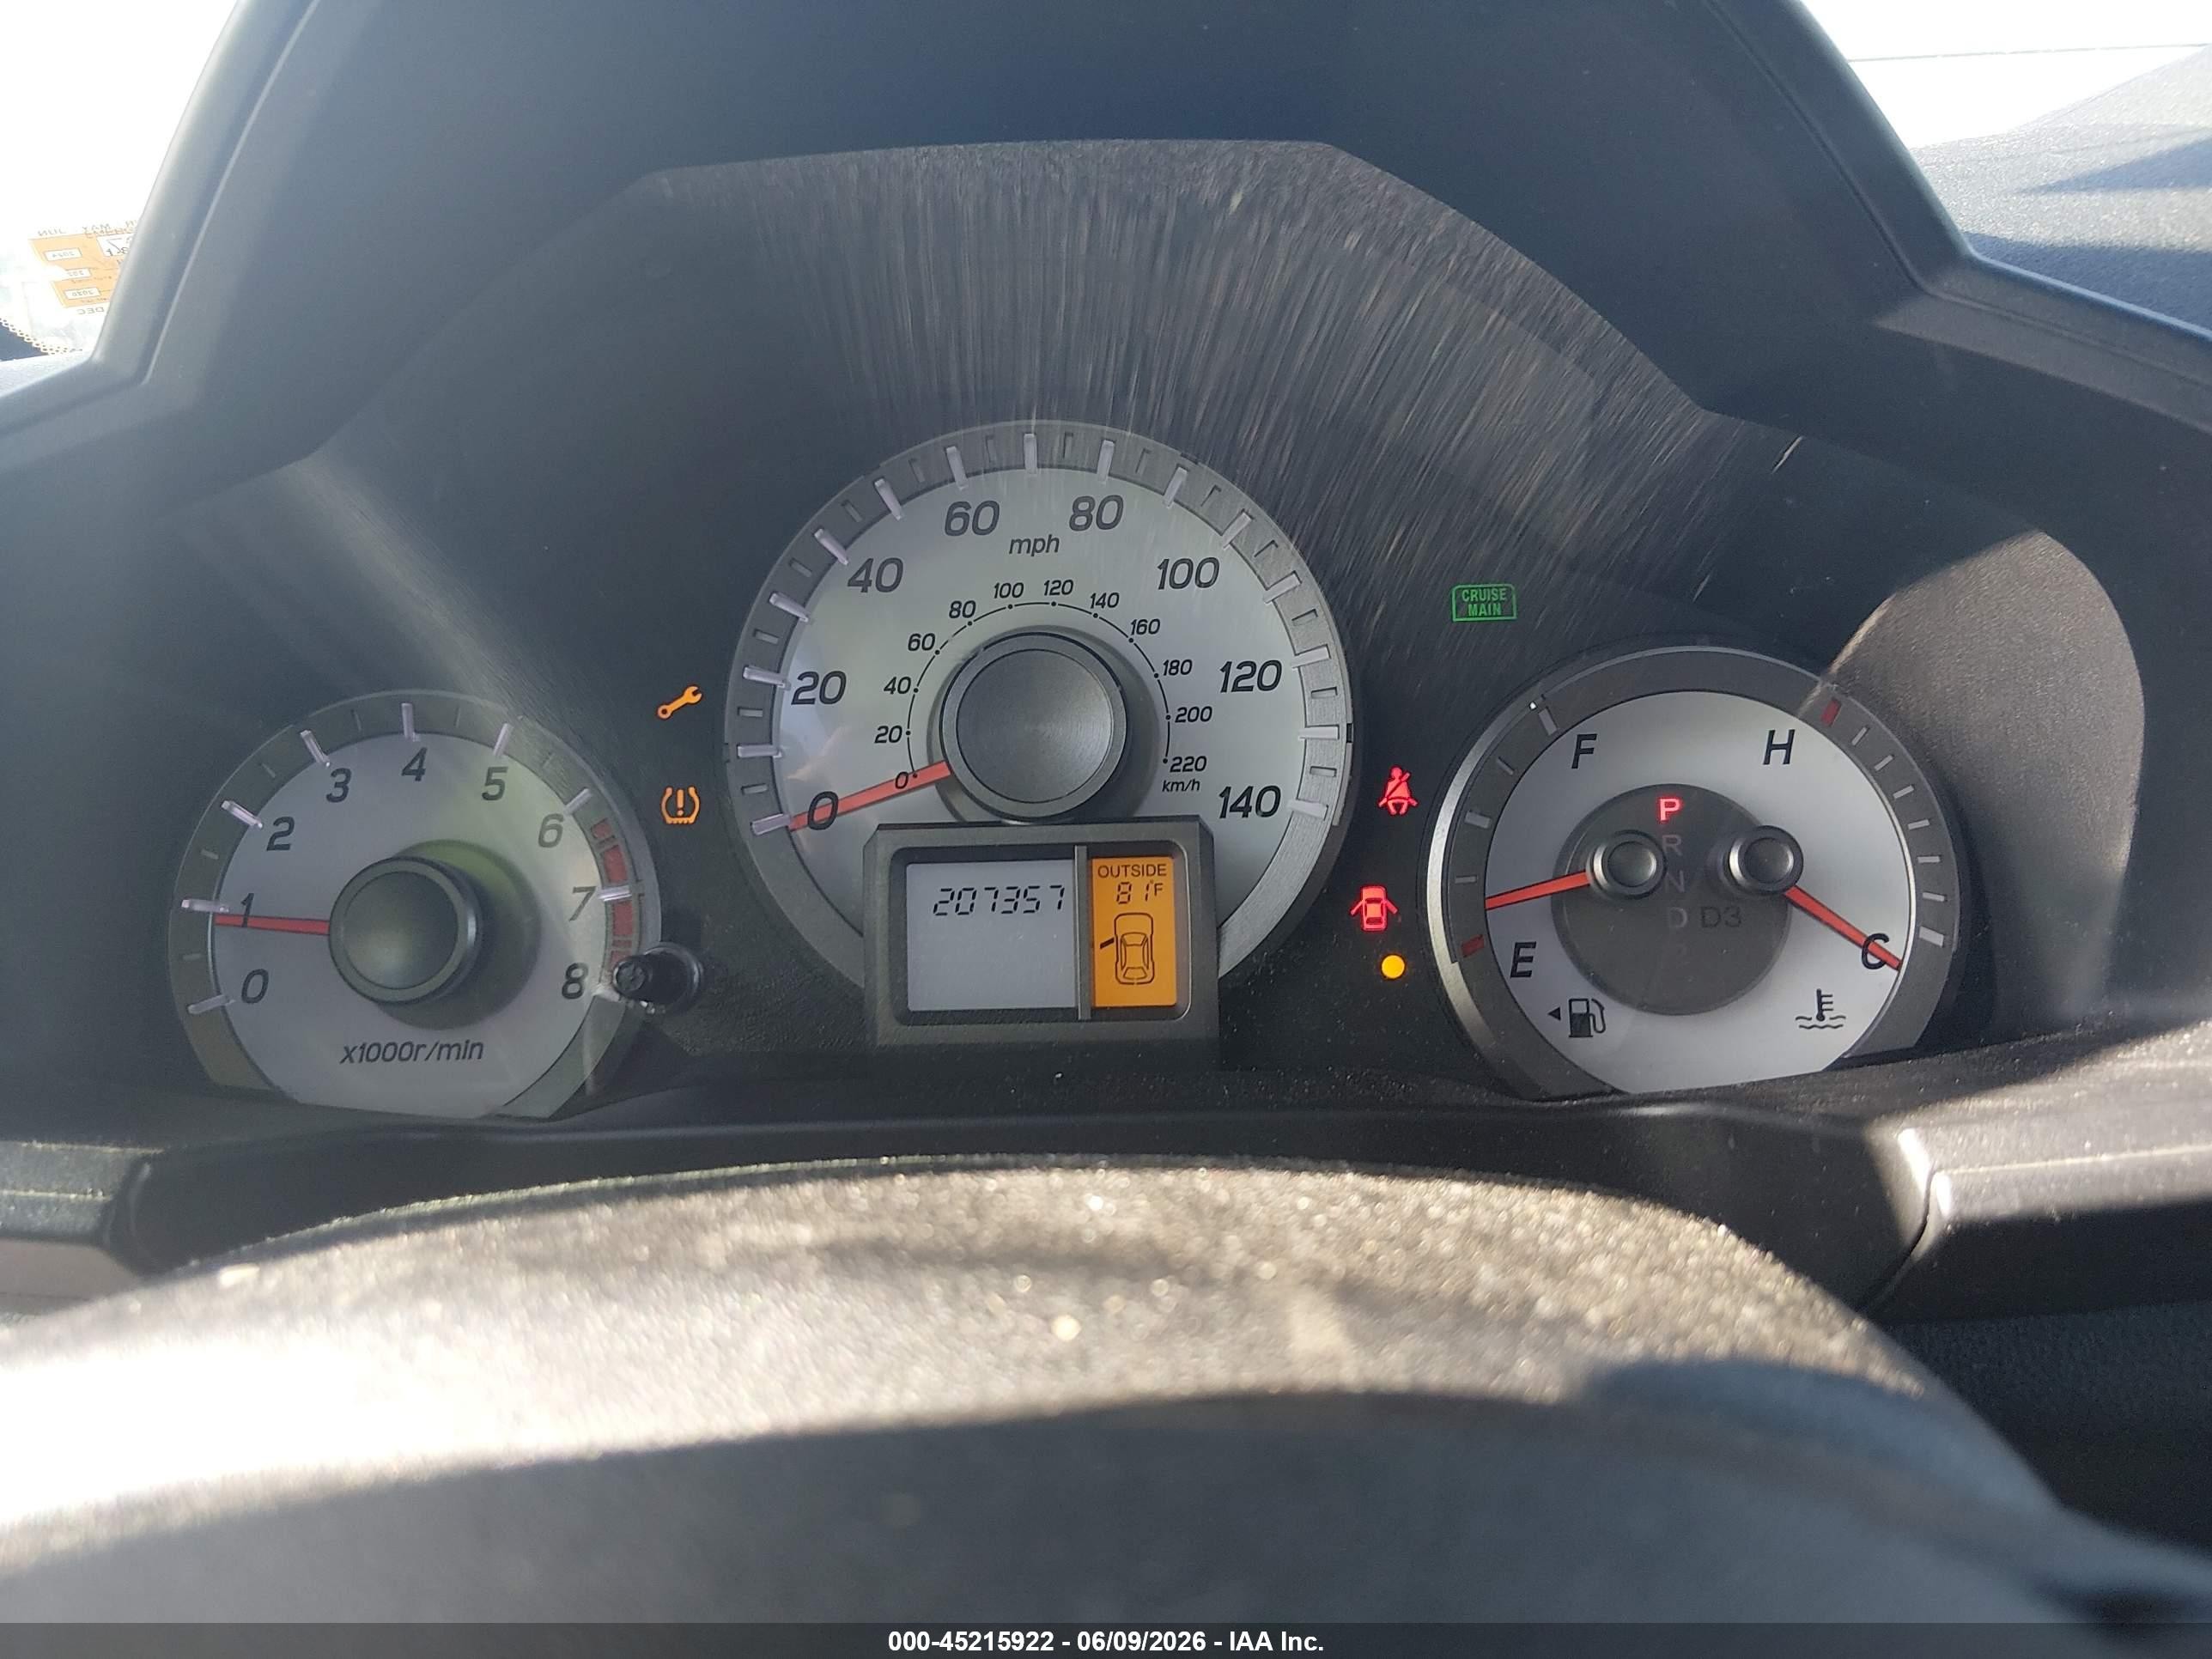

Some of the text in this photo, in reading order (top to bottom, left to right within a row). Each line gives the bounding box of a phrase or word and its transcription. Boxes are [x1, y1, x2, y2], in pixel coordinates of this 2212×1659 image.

[944, 501, 1000, 537] 60
[1069, 495, 1123, 531] 80
[1009, 534, 1060, 557] mph
[848, 557, 903, 592] 40
[1043, 580, 1073, 595] 120
[1157, 557, 1219, 590] 100
[993, 582, 1024, 599] 100
[1089, 592, 1120, 610] 140
[1462, 587, 1508, 601] CRUISE
[948, 601, 976, 618] 80
[1468, 603, 1502, 616] MAIN
[1130, 618, 1161, 635] 160
[907, 634, 935, 651] 60
[1163, 659, 1192, 675] 180
[1219, 660, 1282, 691] 120
[792, 672, 847, 705] 20
[884, 677, 911, 694] 40
[1175, 706, 1212, 722] 200
[874, 726, 902, 744] 20
[1763, 729, 1796, 765] H
[401, 747, 428, 781] 4
[1170, 756, 1206, 773] 220
[1571, 733, 1597, 769] F
[325, 769, 352, 802] 3
[482, 768, 507, 800] 5
[895, 771, 908, 789] 0
[1162, 778, 1200, 793] km/h
[808, 792, 838, 830] 0
[1218, 786, 1280, 819] 140
[1658, 797, 1682, 823] P
[266, 817, 295, 851] 2
[538, 814, 563, 848] 6
[1662, 835, 1682, 856] R
[1097, 864, 1167, 878] OUTSIDE
[1665, 871, 1685, 893] N
[241, 893, 255, 928] 1
[568, 886, 597, 921] 7
[933, 885, 1065, 916] 207357
[1668, 906, 1741, 928] D D3
[1510, 942, 1536, 978] E
[1861, 933, 1891, 970] C
[240, 969, 270, 1004] 0
[561, 963, 589, 999] 8
[340, 1040, 483, 1064] x1000r/min
